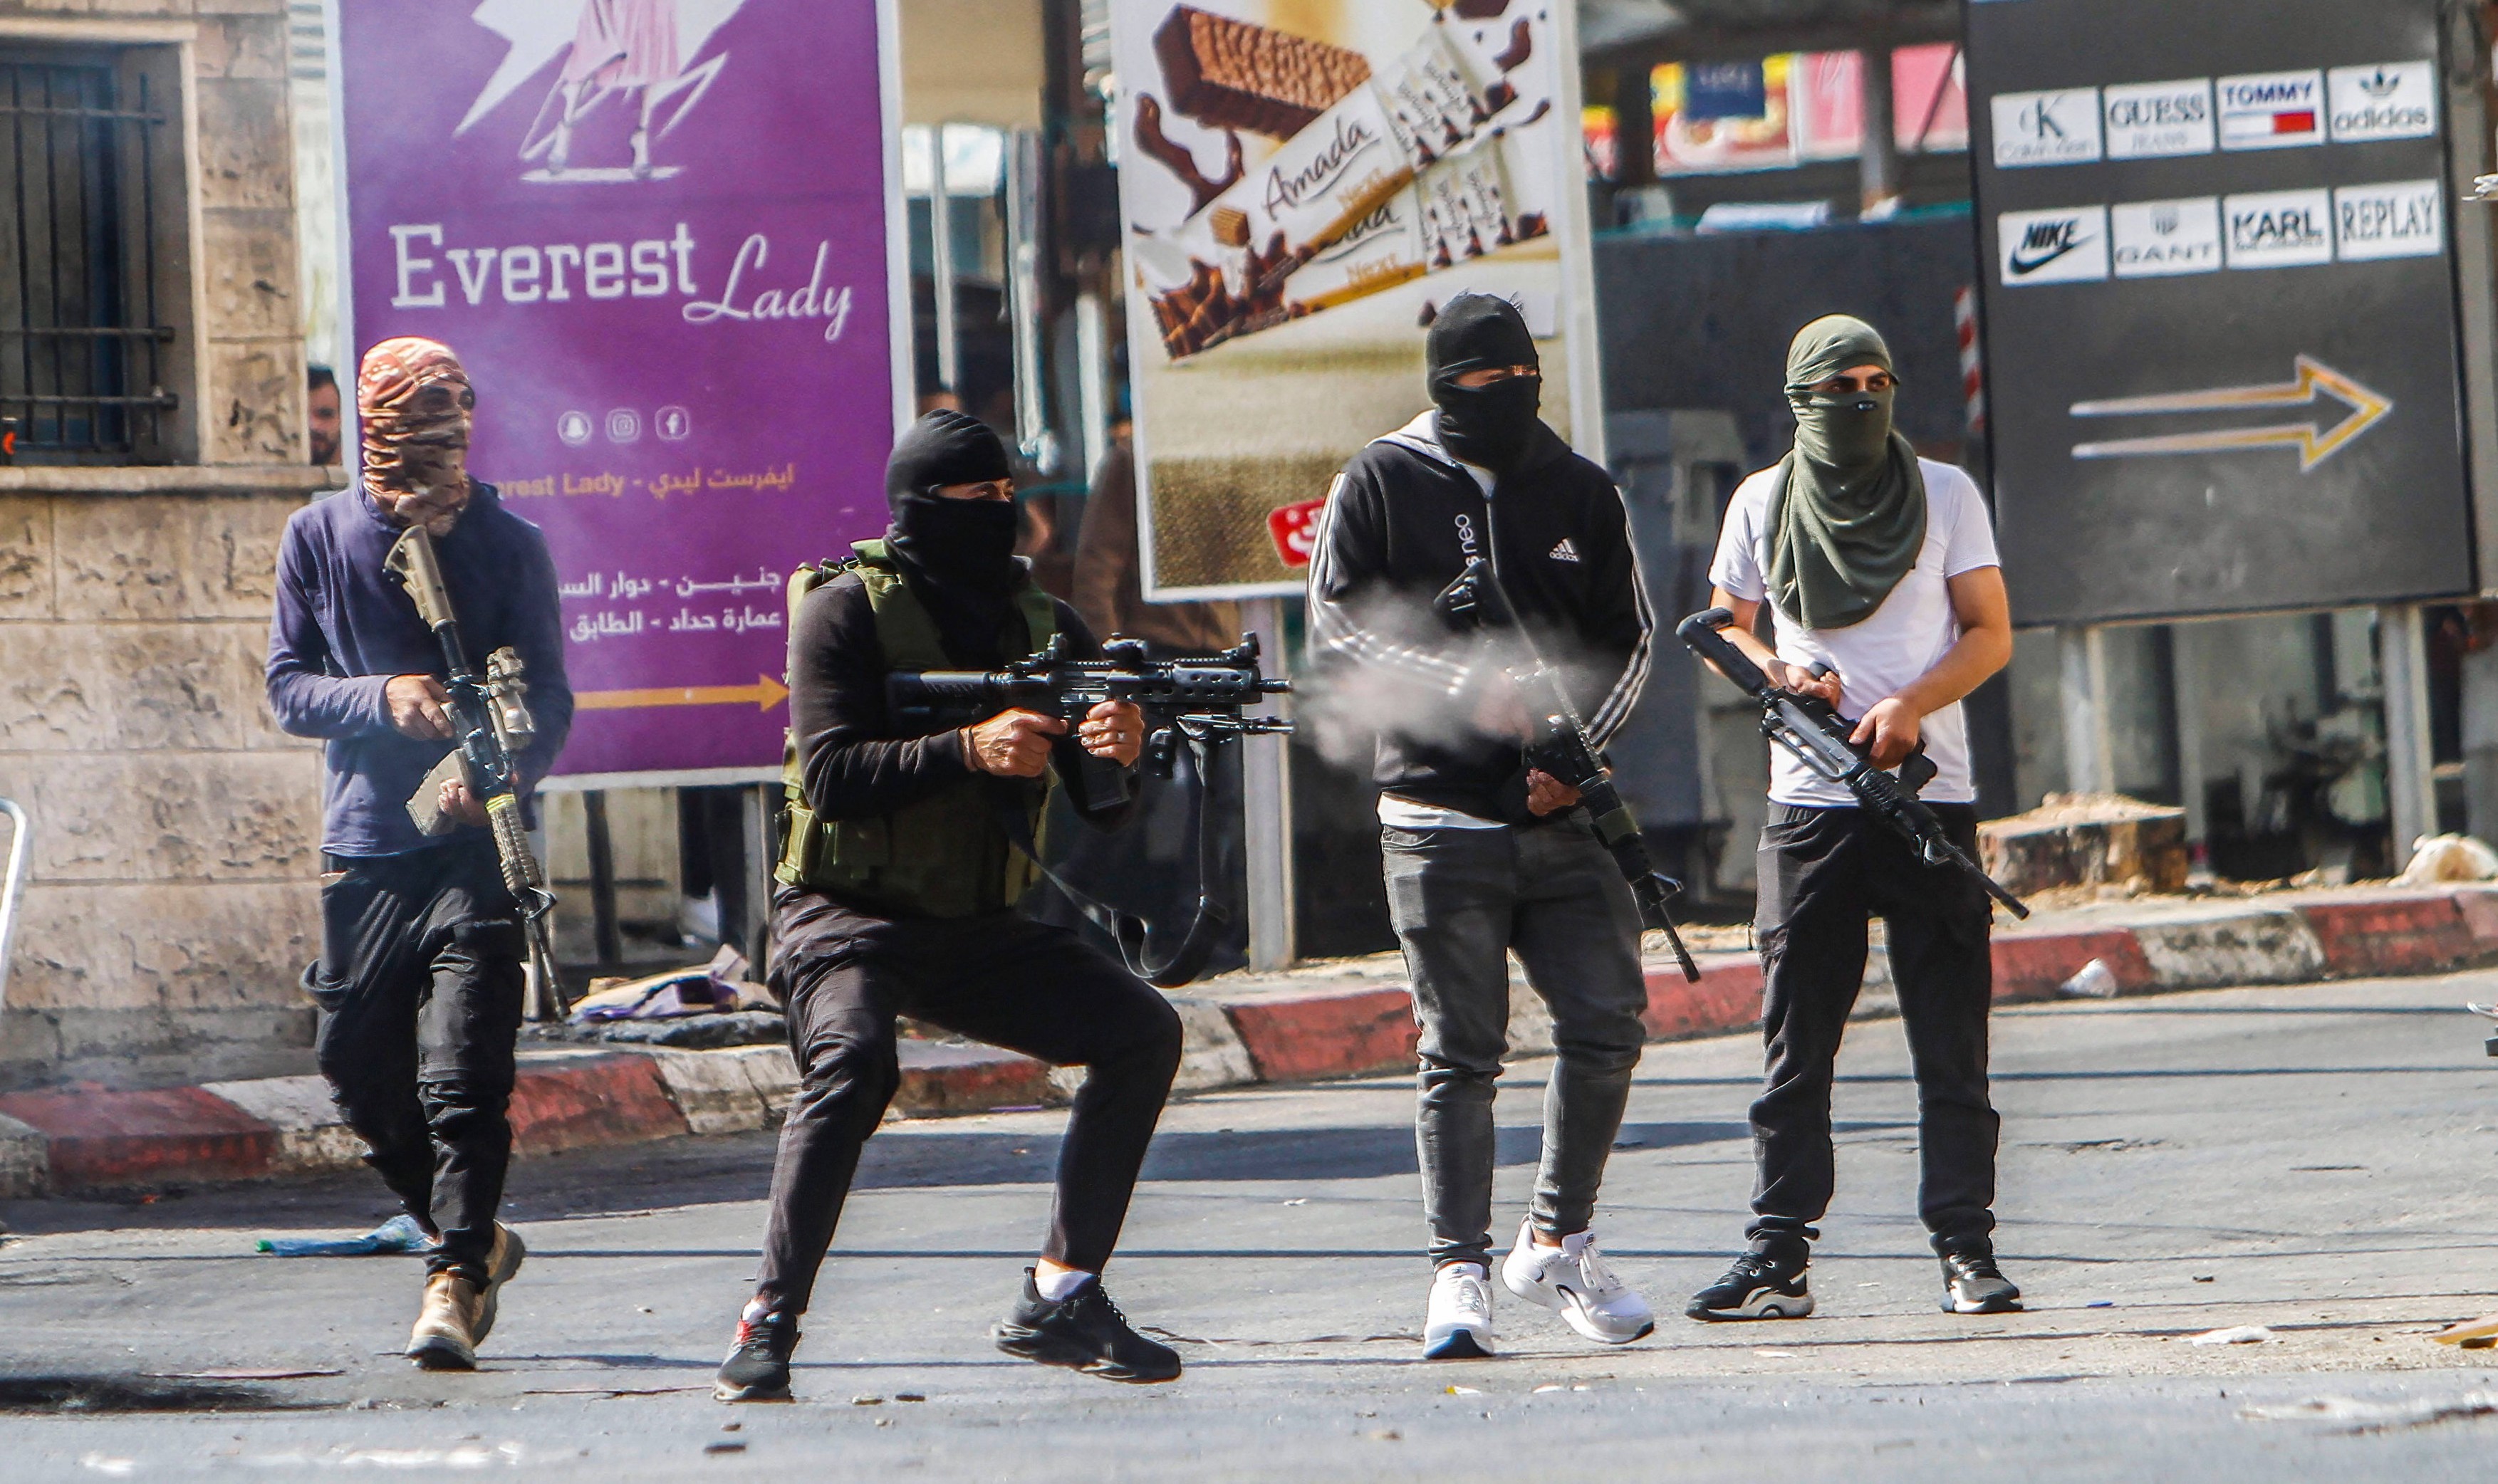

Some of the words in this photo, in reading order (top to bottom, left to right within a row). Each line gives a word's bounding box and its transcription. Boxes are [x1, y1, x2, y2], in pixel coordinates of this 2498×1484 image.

[2224, 80, 2313, 107] TOMMY
[2110, 93, 2206, 128] GUESS
[2334, 107, 2428, 131] adidas
[1261, 114, 1373, 222] Amada
[2232, 207, 2324, 239] KARL
[2341, 192, 2436, 241] REPLAY
[2021, 219, 2079, 250] NIKE
[388, 222, 698, 308] Everest
[682, 234, 852, 342] Lady
[496, 474, 555, 497] erest
[562, 471, 626, 498] Lady
[647, 467, 702, 501] ليدي
[1454, 513, 1478, 554] neo
[608, 570, 651, 599] دوار
[569, 610, 642, 643] الطابق
[668, 608, 717, 632] حداد
[722, 605, 781, 634] عمارة
